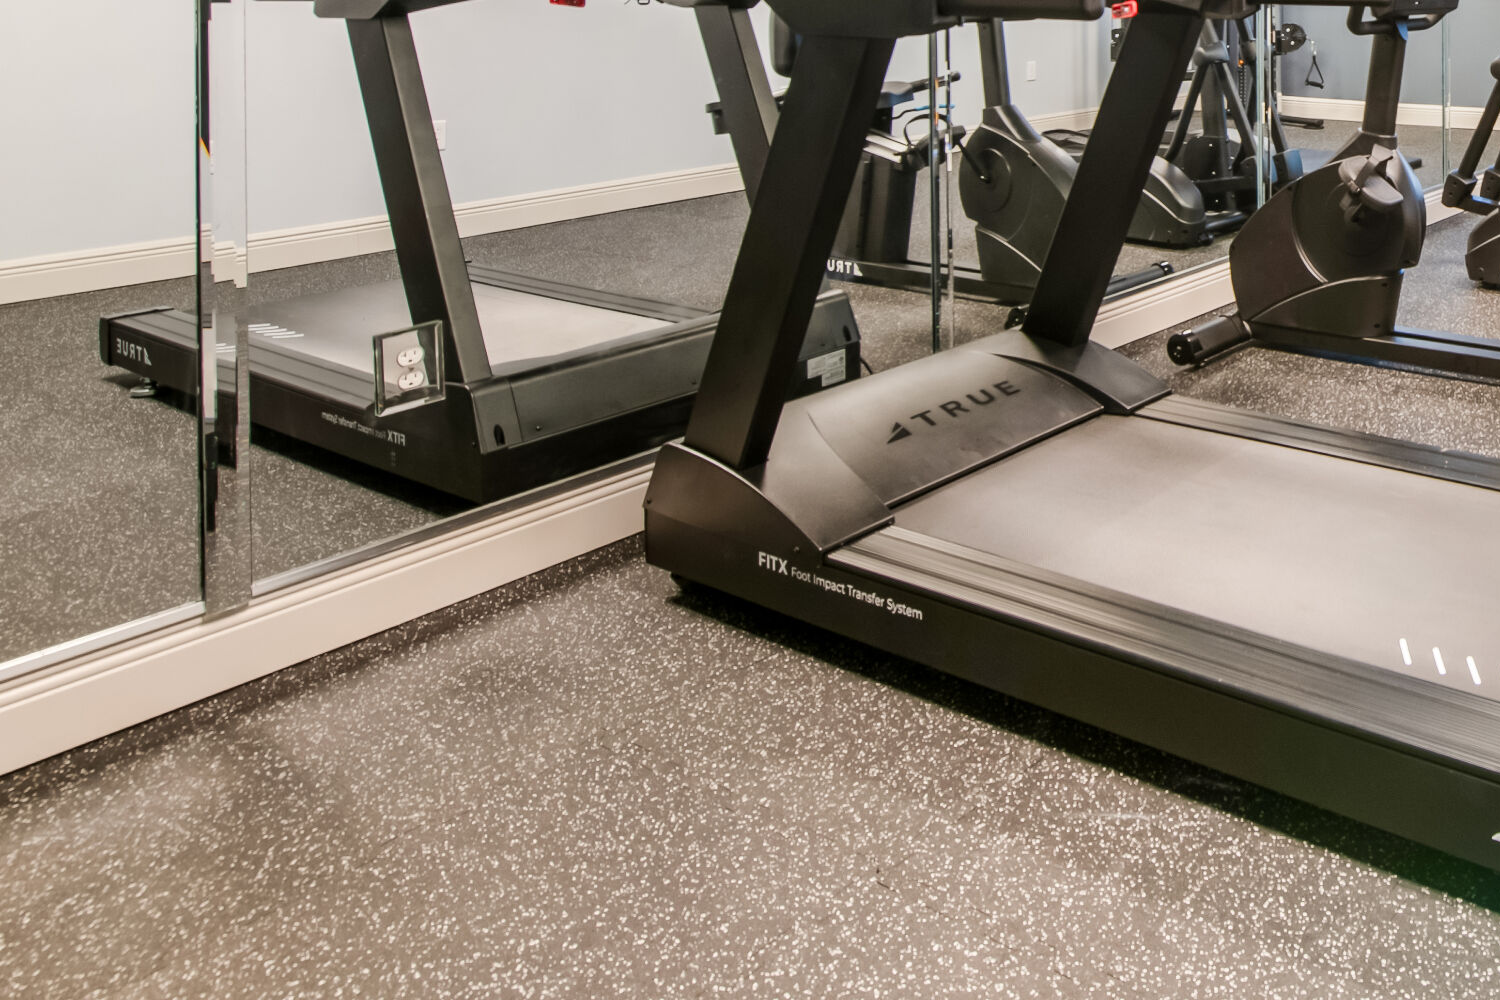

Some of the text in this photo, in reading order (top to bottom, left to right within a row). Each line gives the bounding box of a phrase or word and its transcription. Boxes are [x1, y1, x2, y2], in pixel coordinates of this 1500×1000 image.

[909, 380, 1022, 427] TRUE
[758, 551, 923, 621] FITX Foot Impact Transfer System
